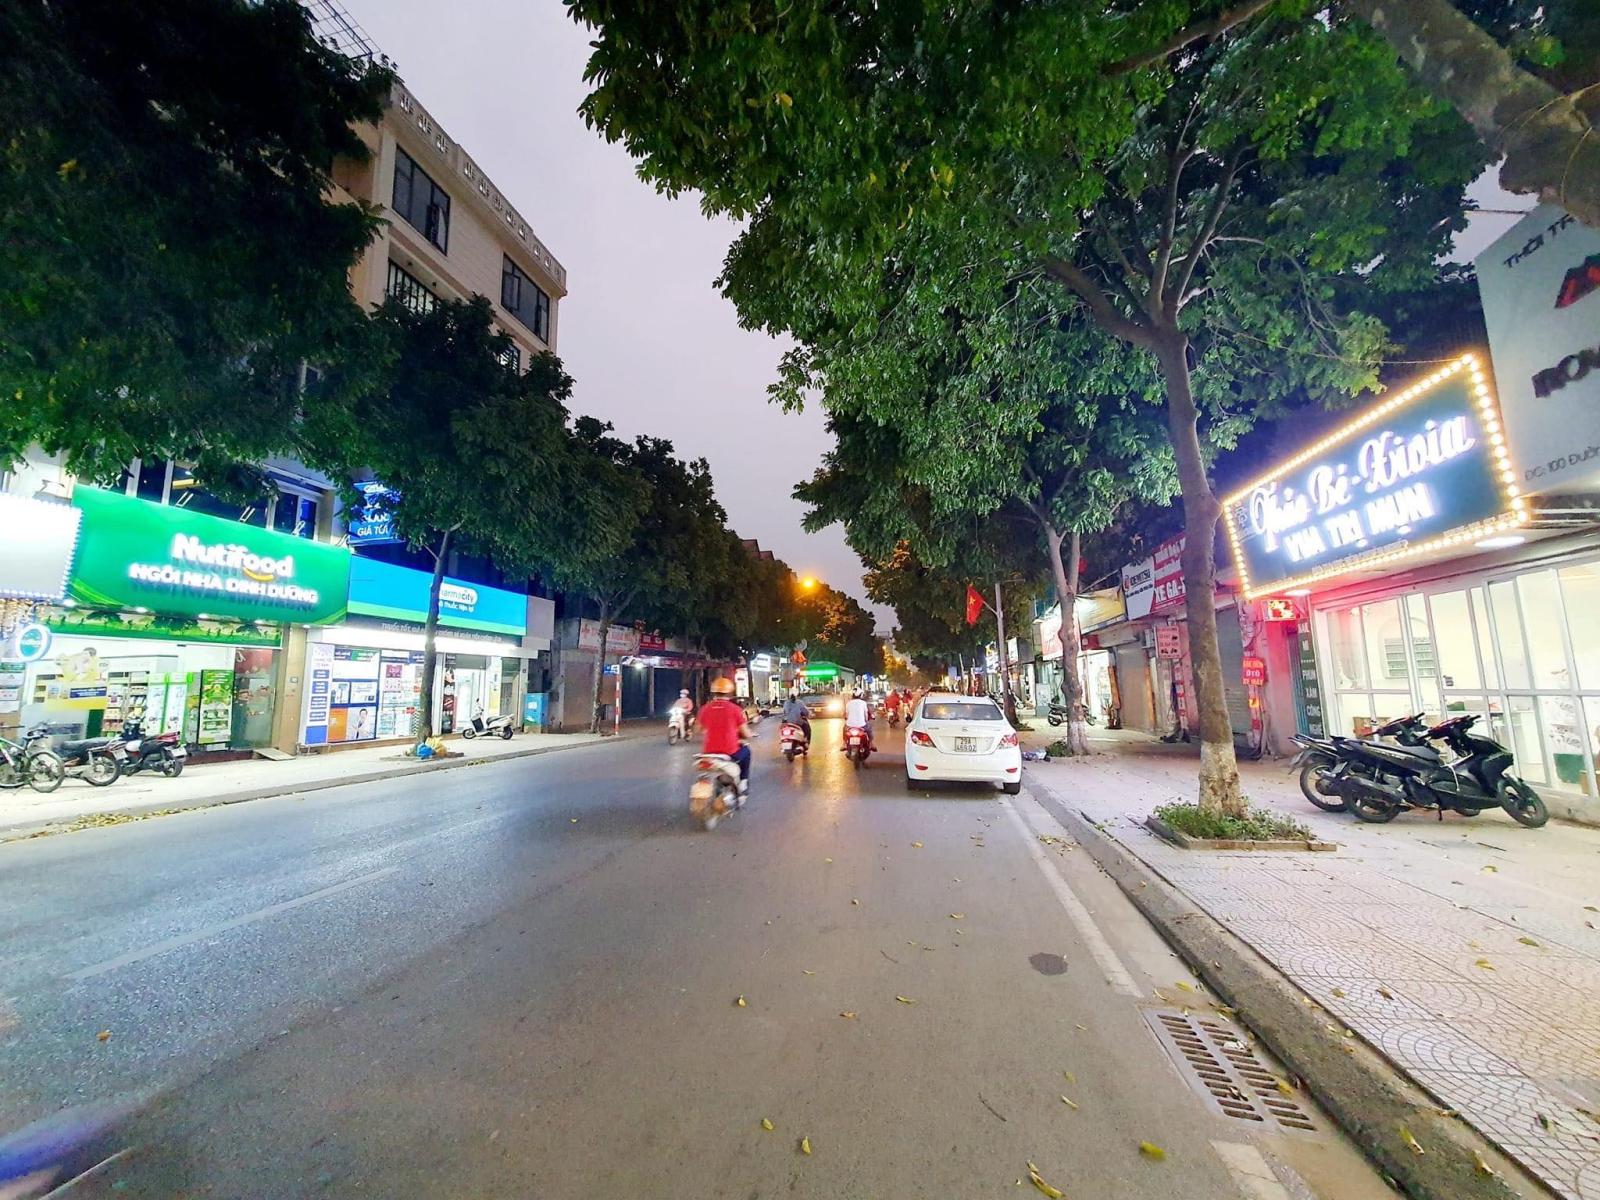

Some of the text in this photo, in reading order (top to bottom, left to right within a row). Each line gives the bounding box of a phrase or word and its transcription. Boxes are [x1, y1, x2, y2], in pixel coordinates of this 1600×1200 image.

[1548, 457, 1567, 472] 100
[1364, 482, 1434, 535] MỤN
[357, 525, 372, 536] GIÁ
[171, 533, 293, 578] Nutifood
[129, 562, 182, 585] NGÔI
[182, 571, 224, 590] NHÀ
